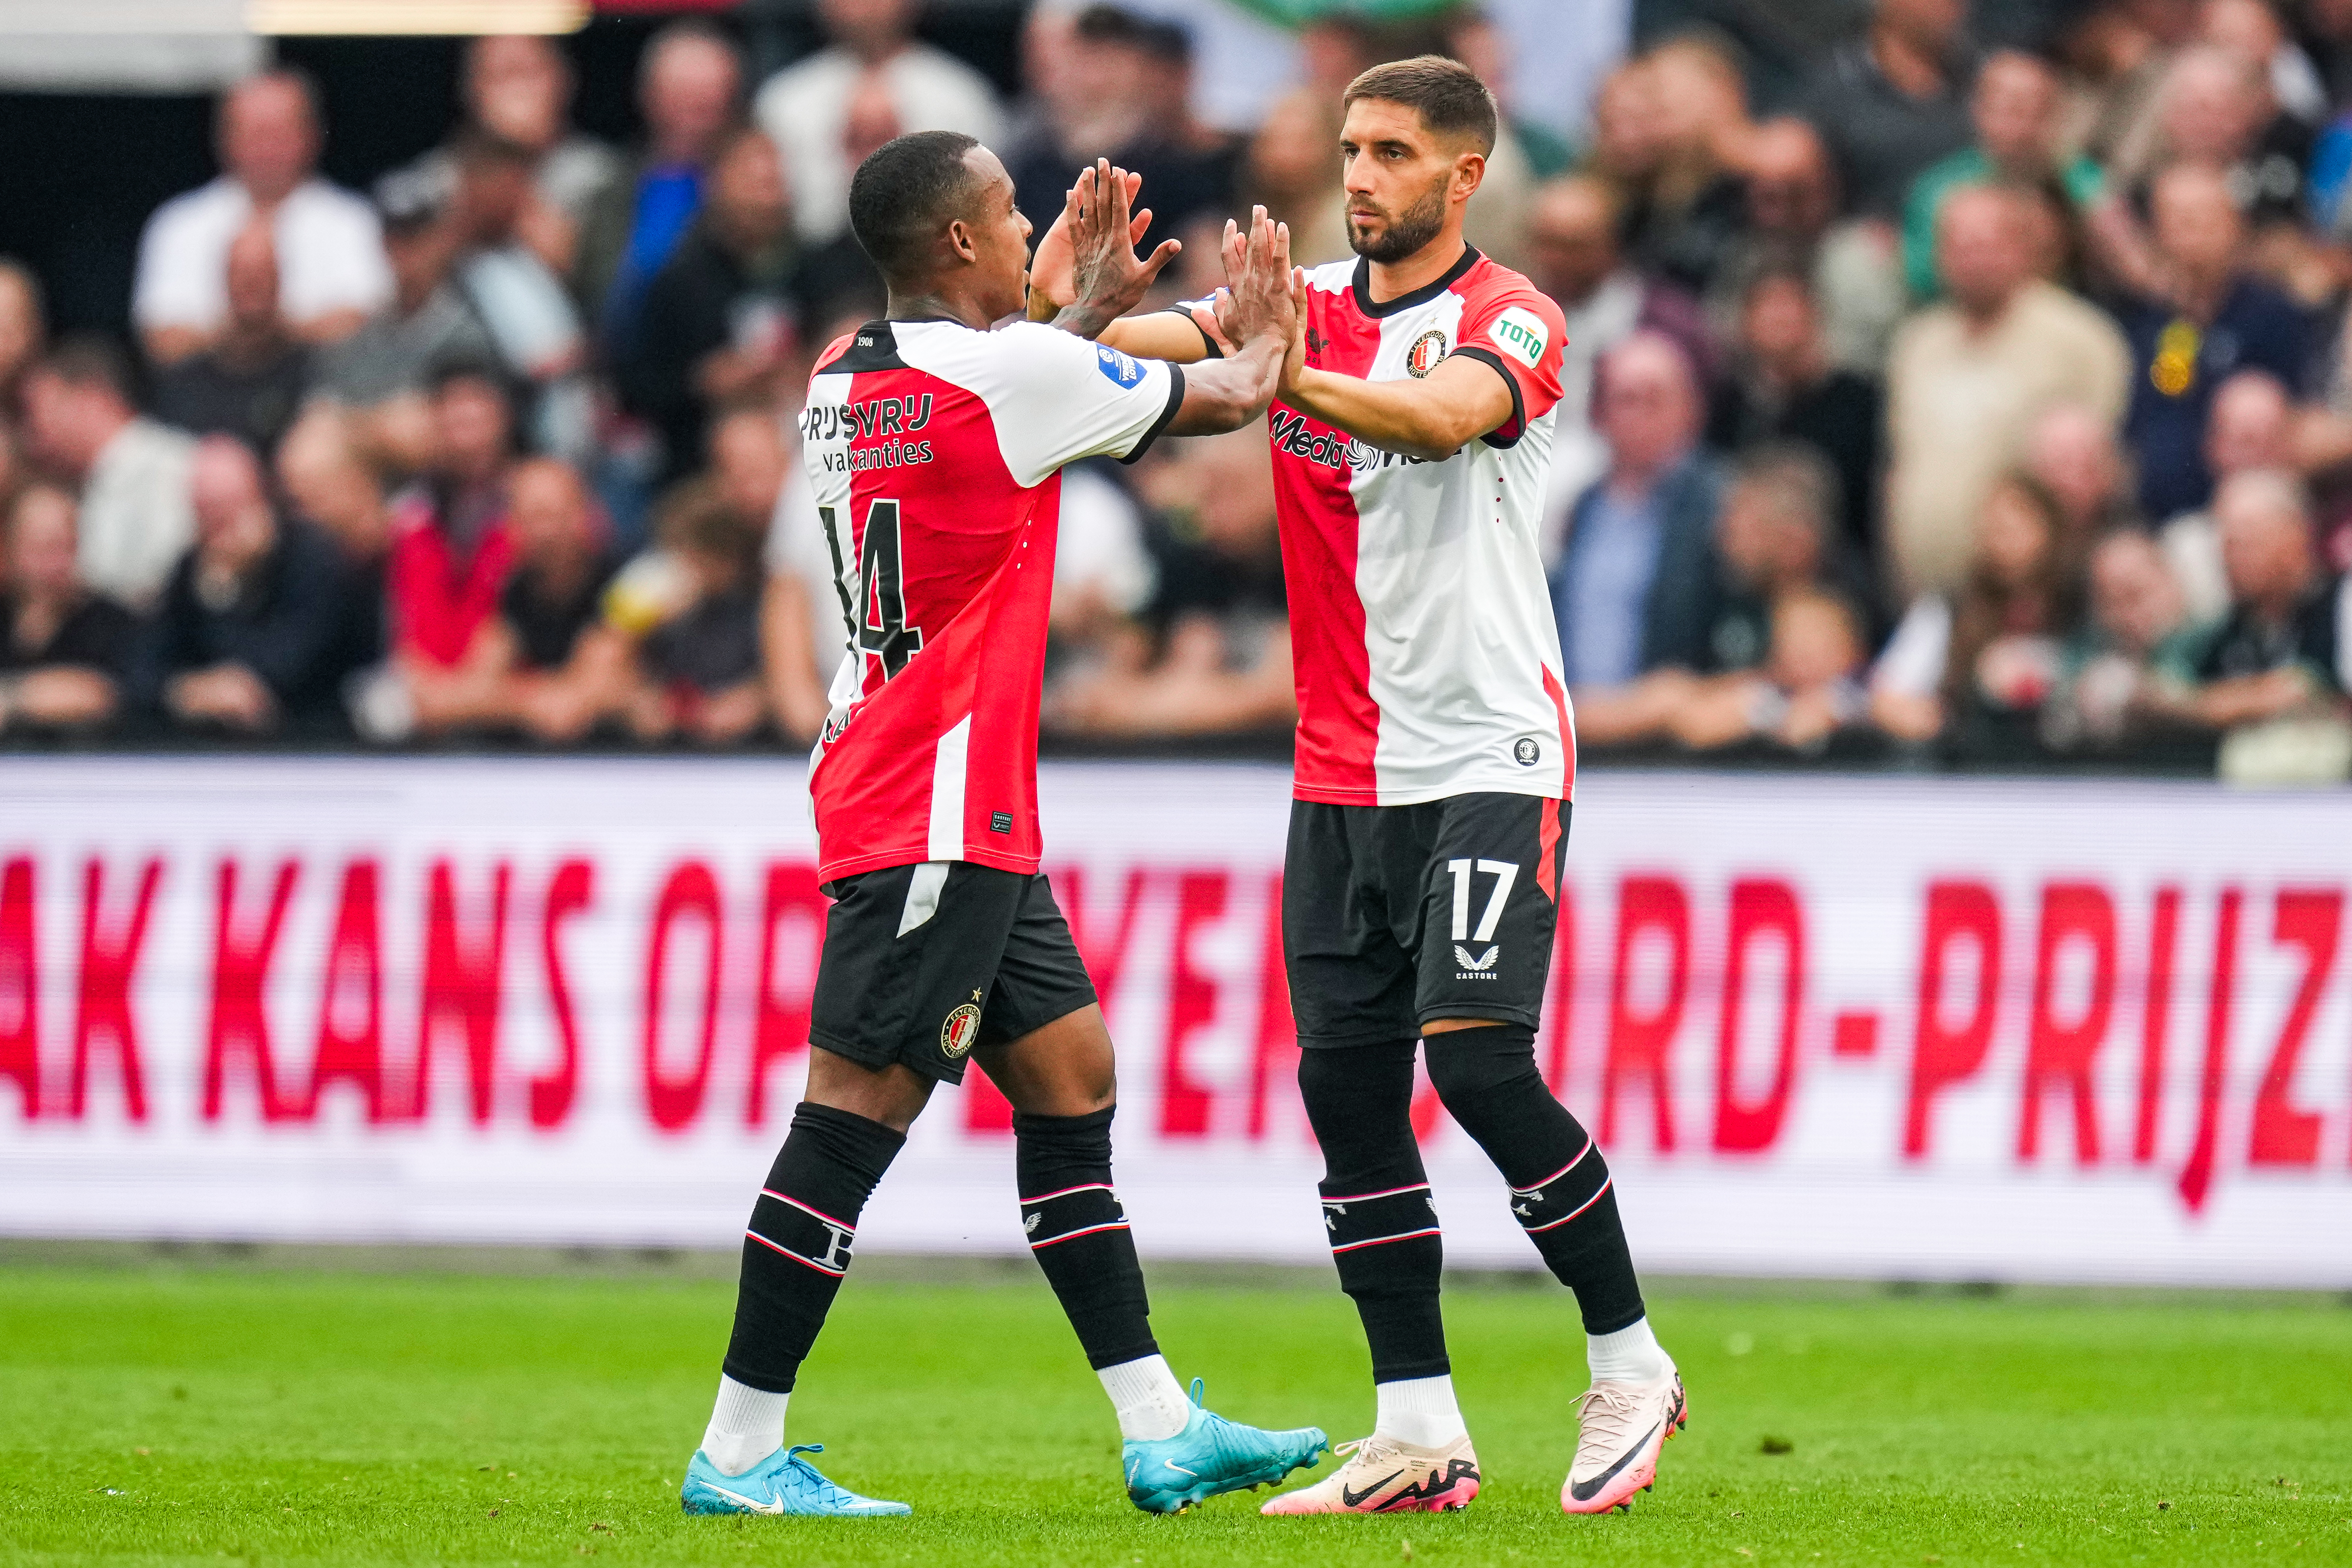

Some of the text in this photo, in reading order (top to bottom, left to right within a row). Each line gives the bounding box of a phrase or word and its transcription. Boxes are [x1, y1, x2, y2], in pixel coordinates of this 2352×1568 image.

[857, 337, 873, 347] 1908
[1499, 319, 1542, 359] TOTO
[1408, 355, 1445, 379] ROTTEM
[823, 438, 933, 472] vakanties
[1270, 410, 1345, 469] Media
[818, 498, 924, 697] 14
[1447, 858, 1519, 942] 17
[200, 858, 596, 1133] KANS
[641, 859, 823, 1135] OP
[943, 1034, 972, 1057] ROTTERDAM
